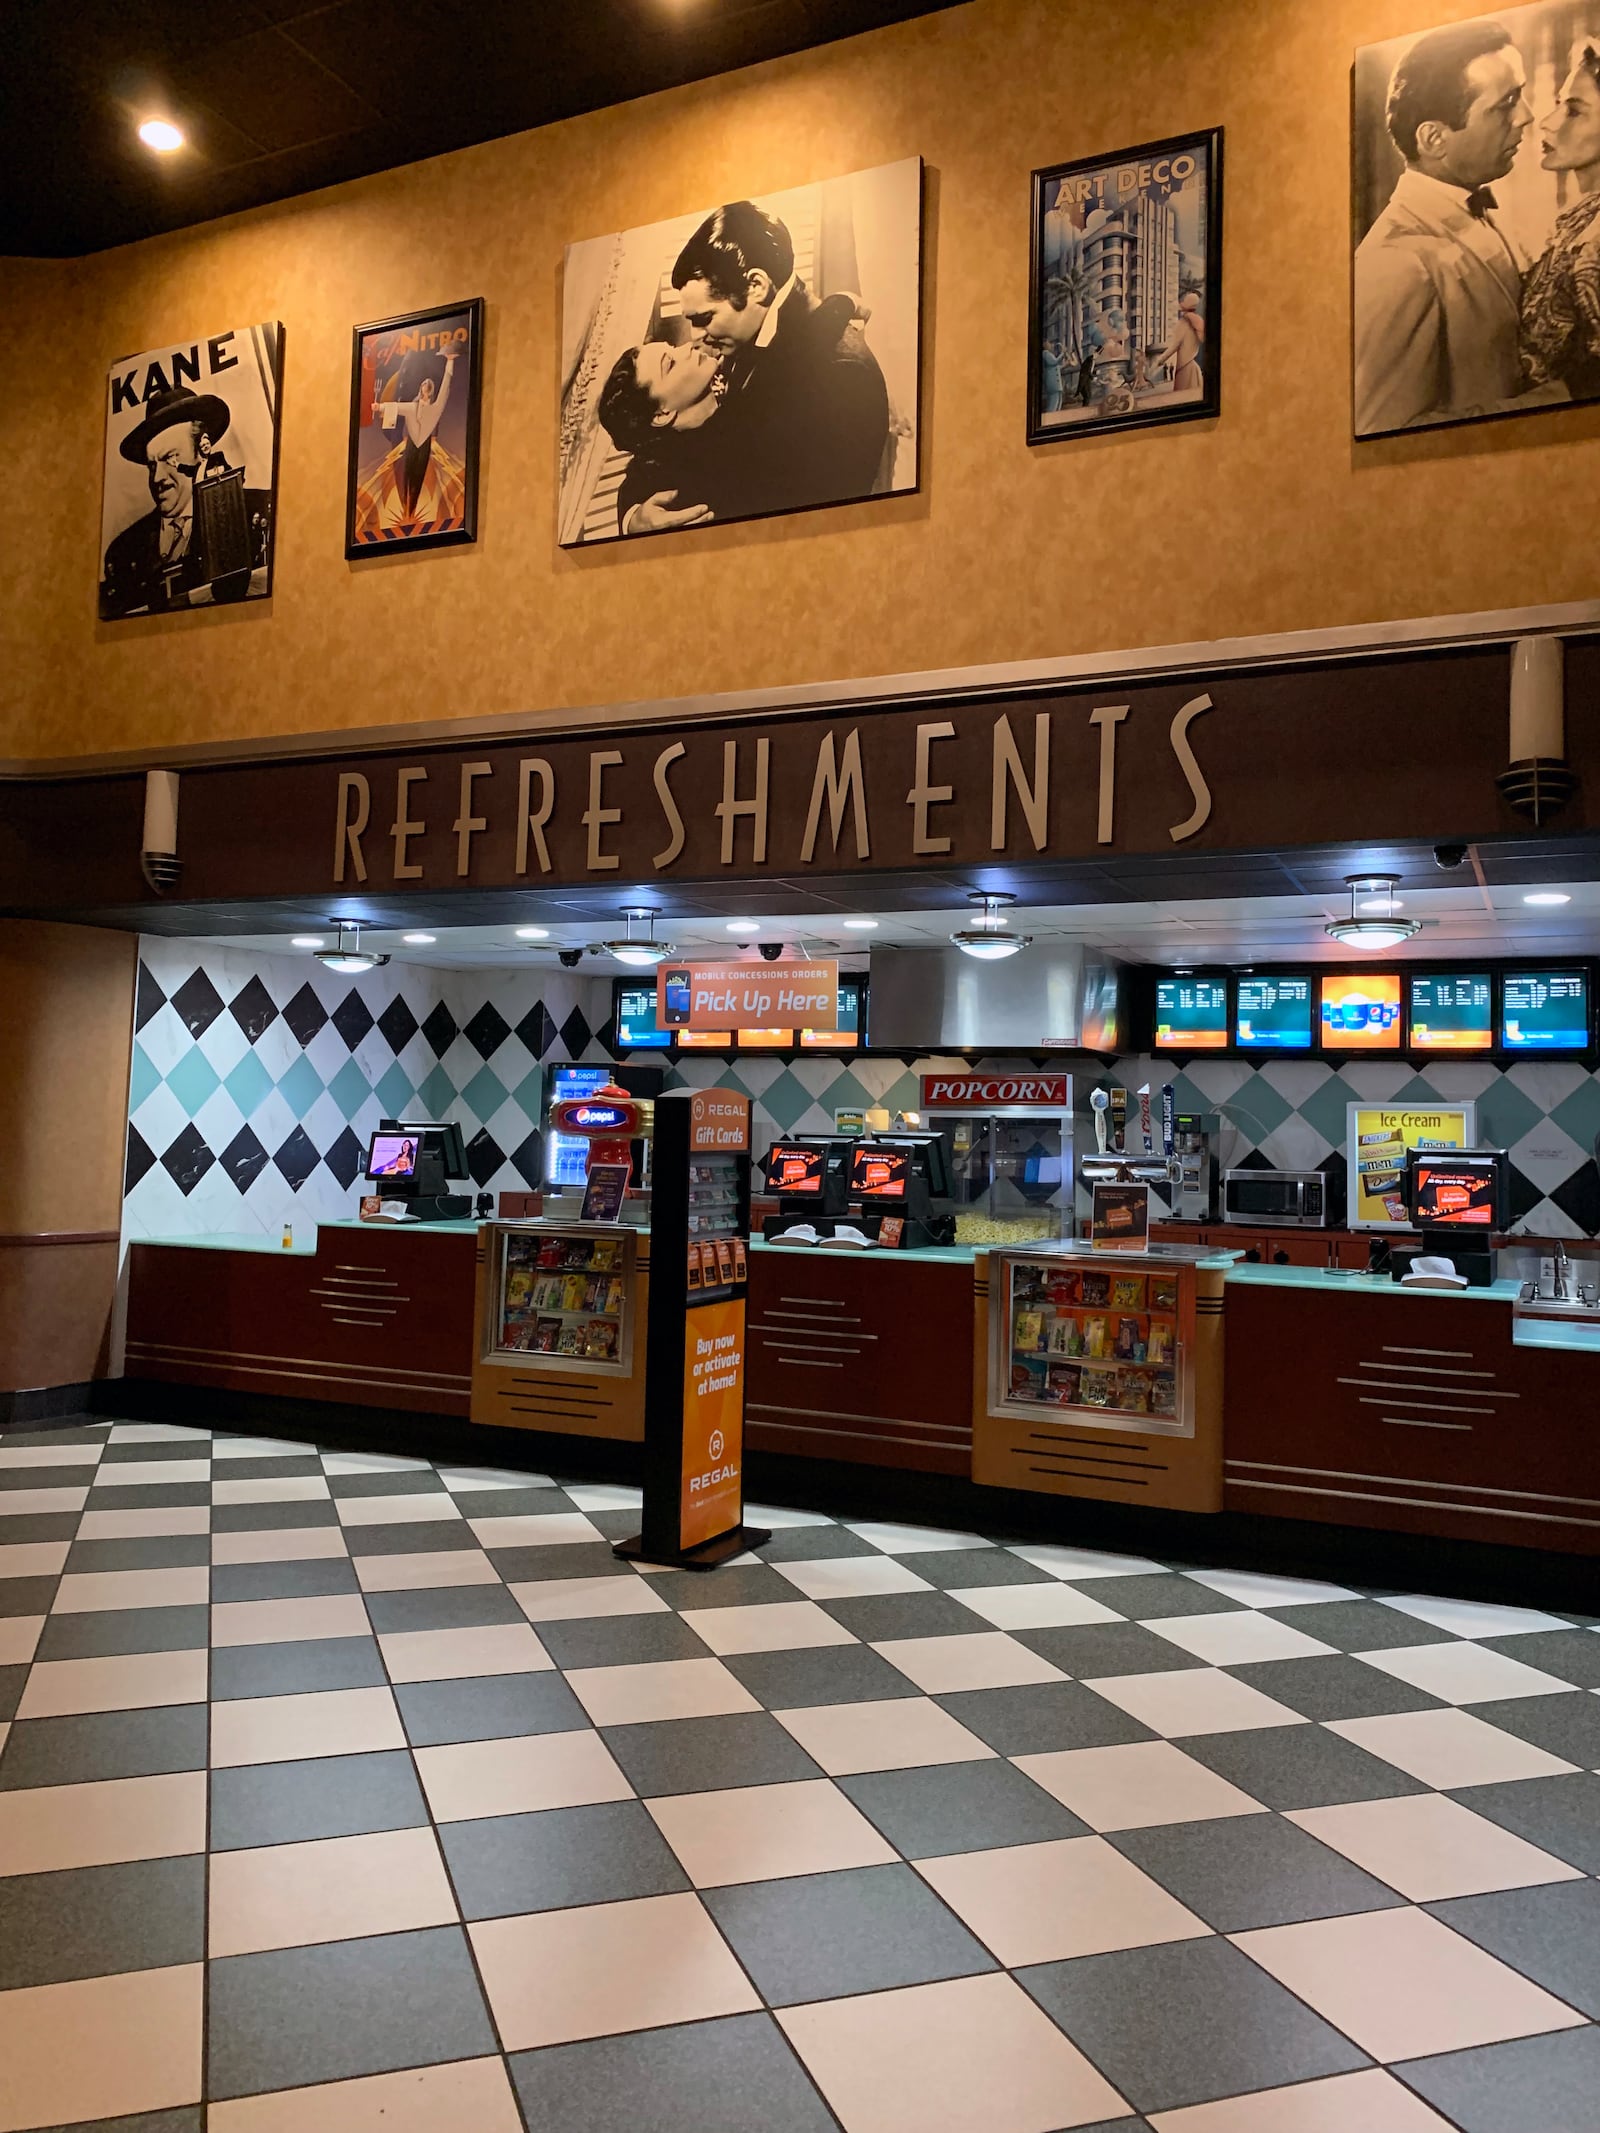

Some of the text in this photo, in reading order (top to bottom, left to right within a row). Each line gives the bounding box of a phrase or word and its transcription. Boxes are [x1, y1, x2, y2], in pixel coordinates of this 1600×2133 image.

[1054, 155, 1196, 208] ART DECO
[400, 327, 469, 356] NITRO
[111, 331, 240, 415] KANE
[334, 692, 1214, 883] REFRESHMENTS
[694, 970, 828, 980] MOBILE CONCESSIONS ORDERS
[694, 989, 737, 1012] Pick
[743, 990, 771, 1018] Up
[777, 989, 829, 1011] Here
[577, 1071, 597, 1080] pepsi
[929, 1080, 1059, 1100] POPCORN
[590, 1111, 615, 1123] pepsi
[708, 1104, 747, 1116] REGAL
[1163, 1094, 1172, 1141] BUD LIGHT
[1380, 1112, 1441, 1128] Ice Cream
[696, 1126, 744, 1144] Gift Cards
[696, 1334, 735, 1356] Buy now
[693, 1351, 741, 1377] or activate
[697, 1369, 737, 1396] at home!
[689, 1463, 739, 1494] REGAL
